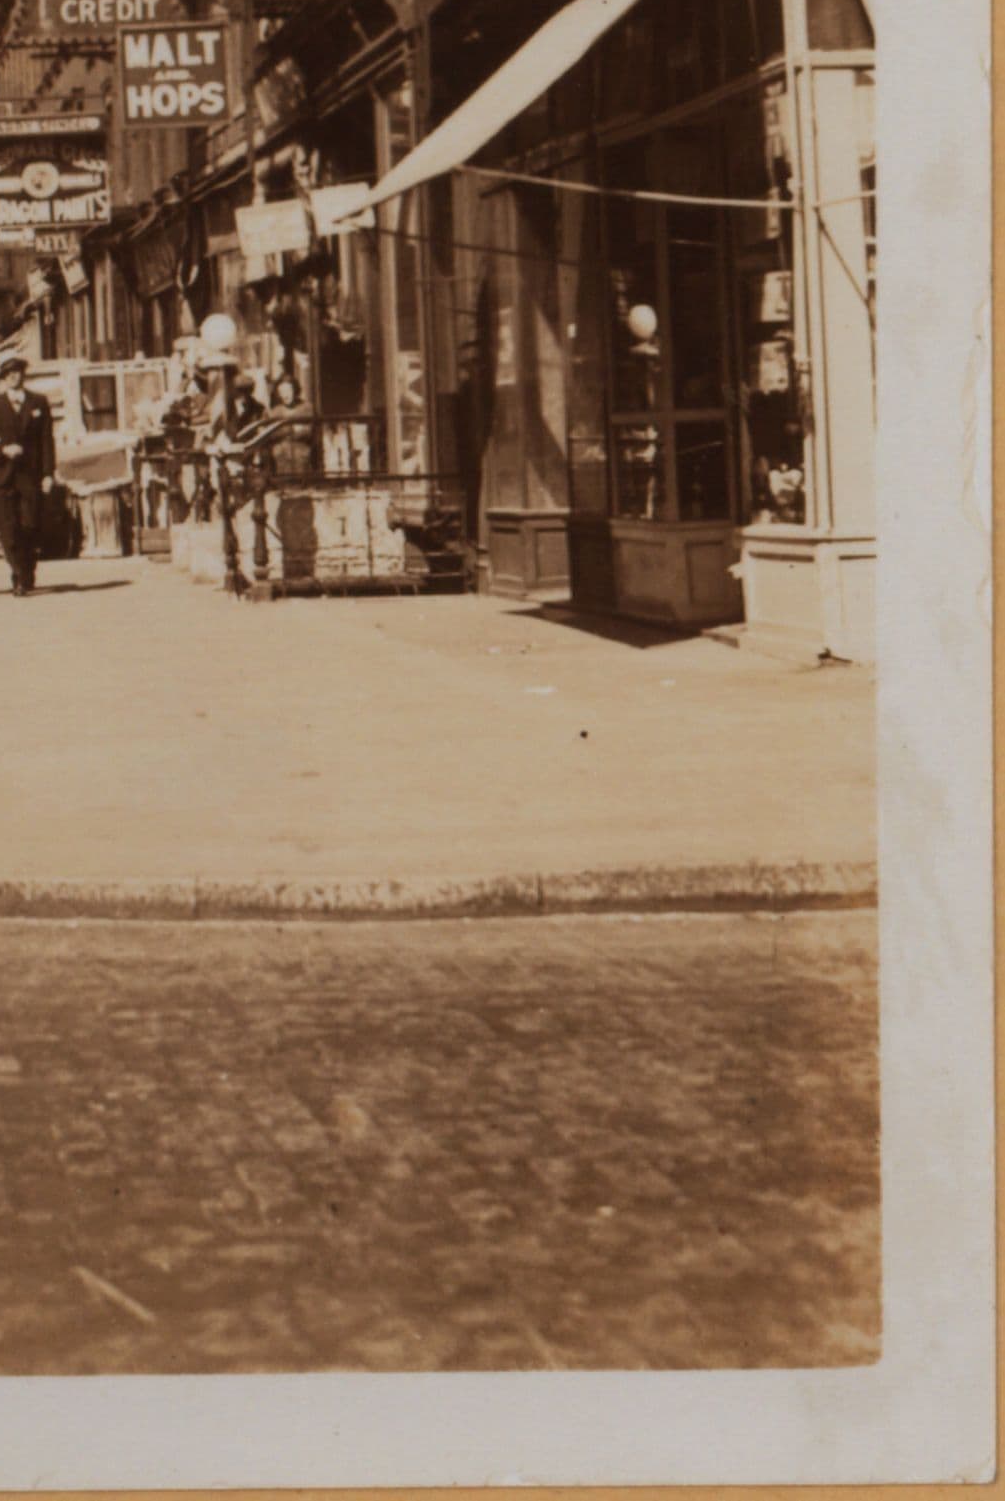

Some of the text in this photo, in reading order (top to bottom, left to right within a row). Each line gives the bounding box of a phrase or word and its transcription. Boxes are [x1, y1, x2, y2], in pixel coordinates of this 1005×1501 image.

[124, 30, 220, 69] MALT
[127, 82, 225, 119] HOPS
[53, 189, 111, 222] PAINTS
